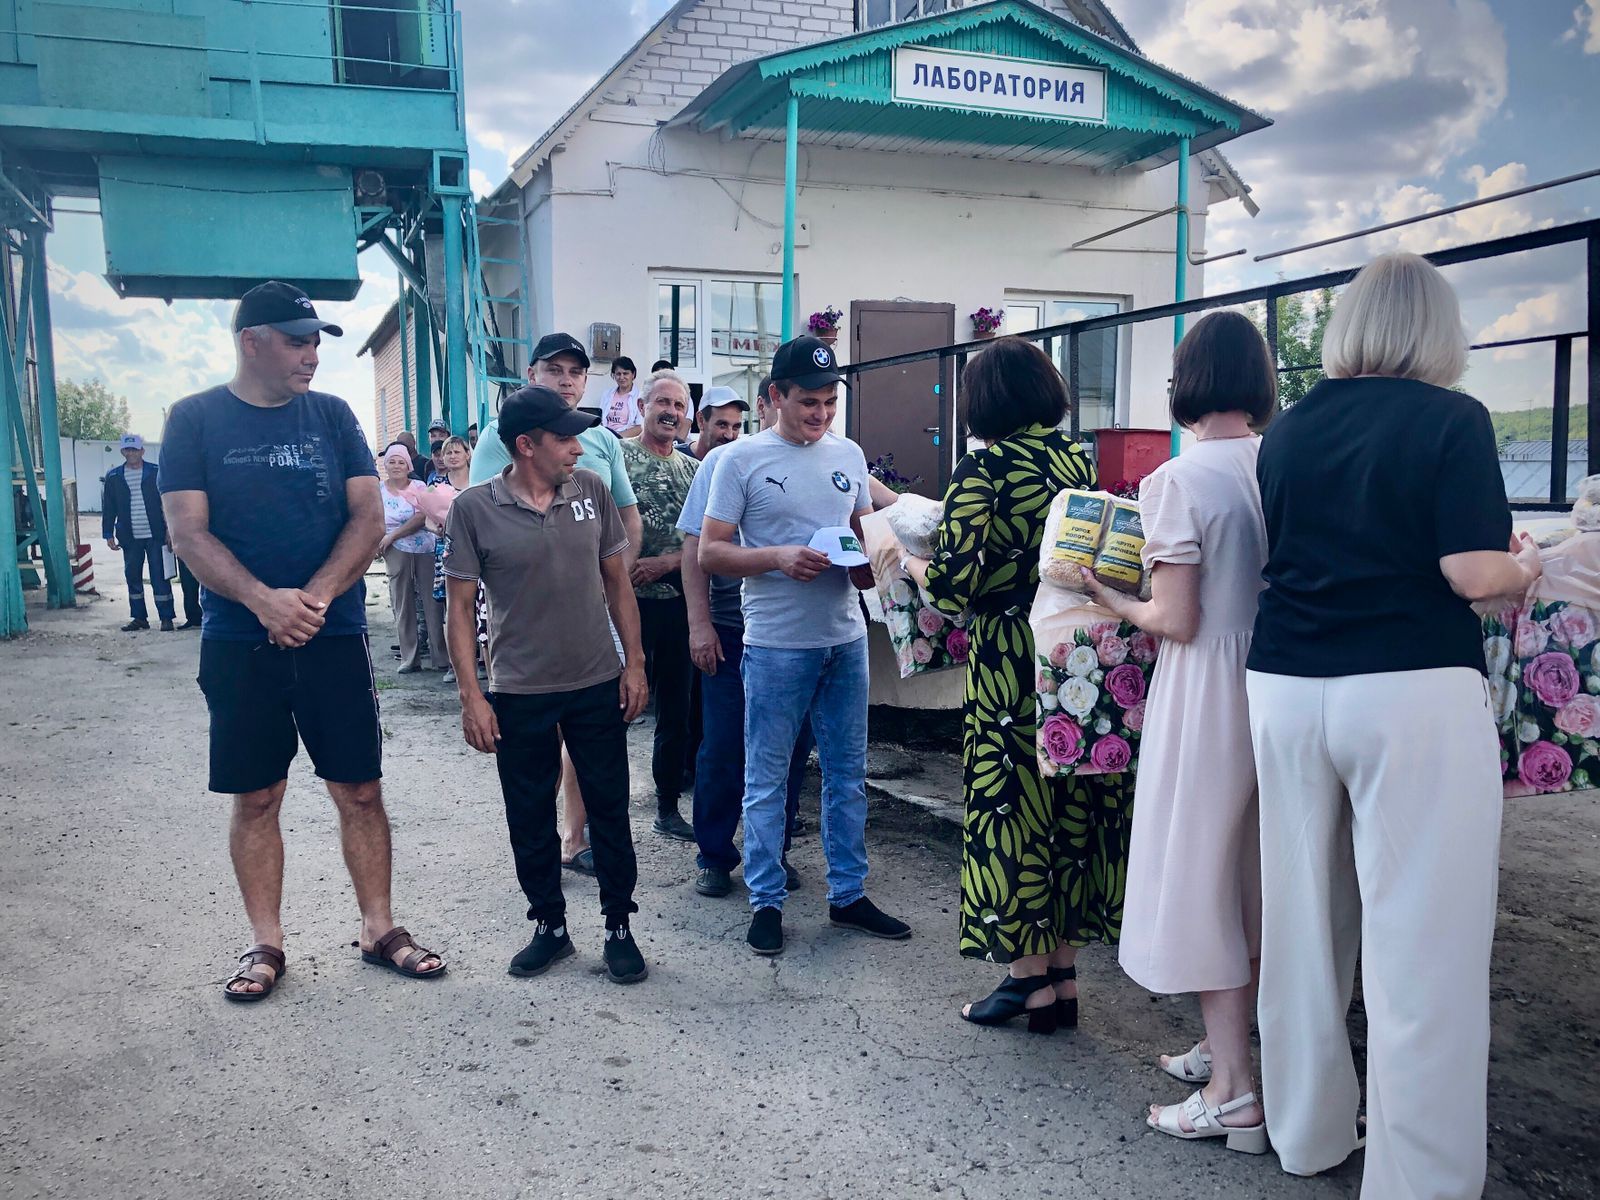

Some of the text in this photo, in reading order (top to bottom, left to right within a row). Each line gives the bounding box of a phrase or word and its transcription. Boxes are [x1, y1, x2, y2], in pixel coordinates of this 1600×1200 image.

[913, 63, 1085, 104] ЛАБОРАТОРИЯ
[268, 455, 301, 468] PORT
[571, 498, 596, 521] DS
